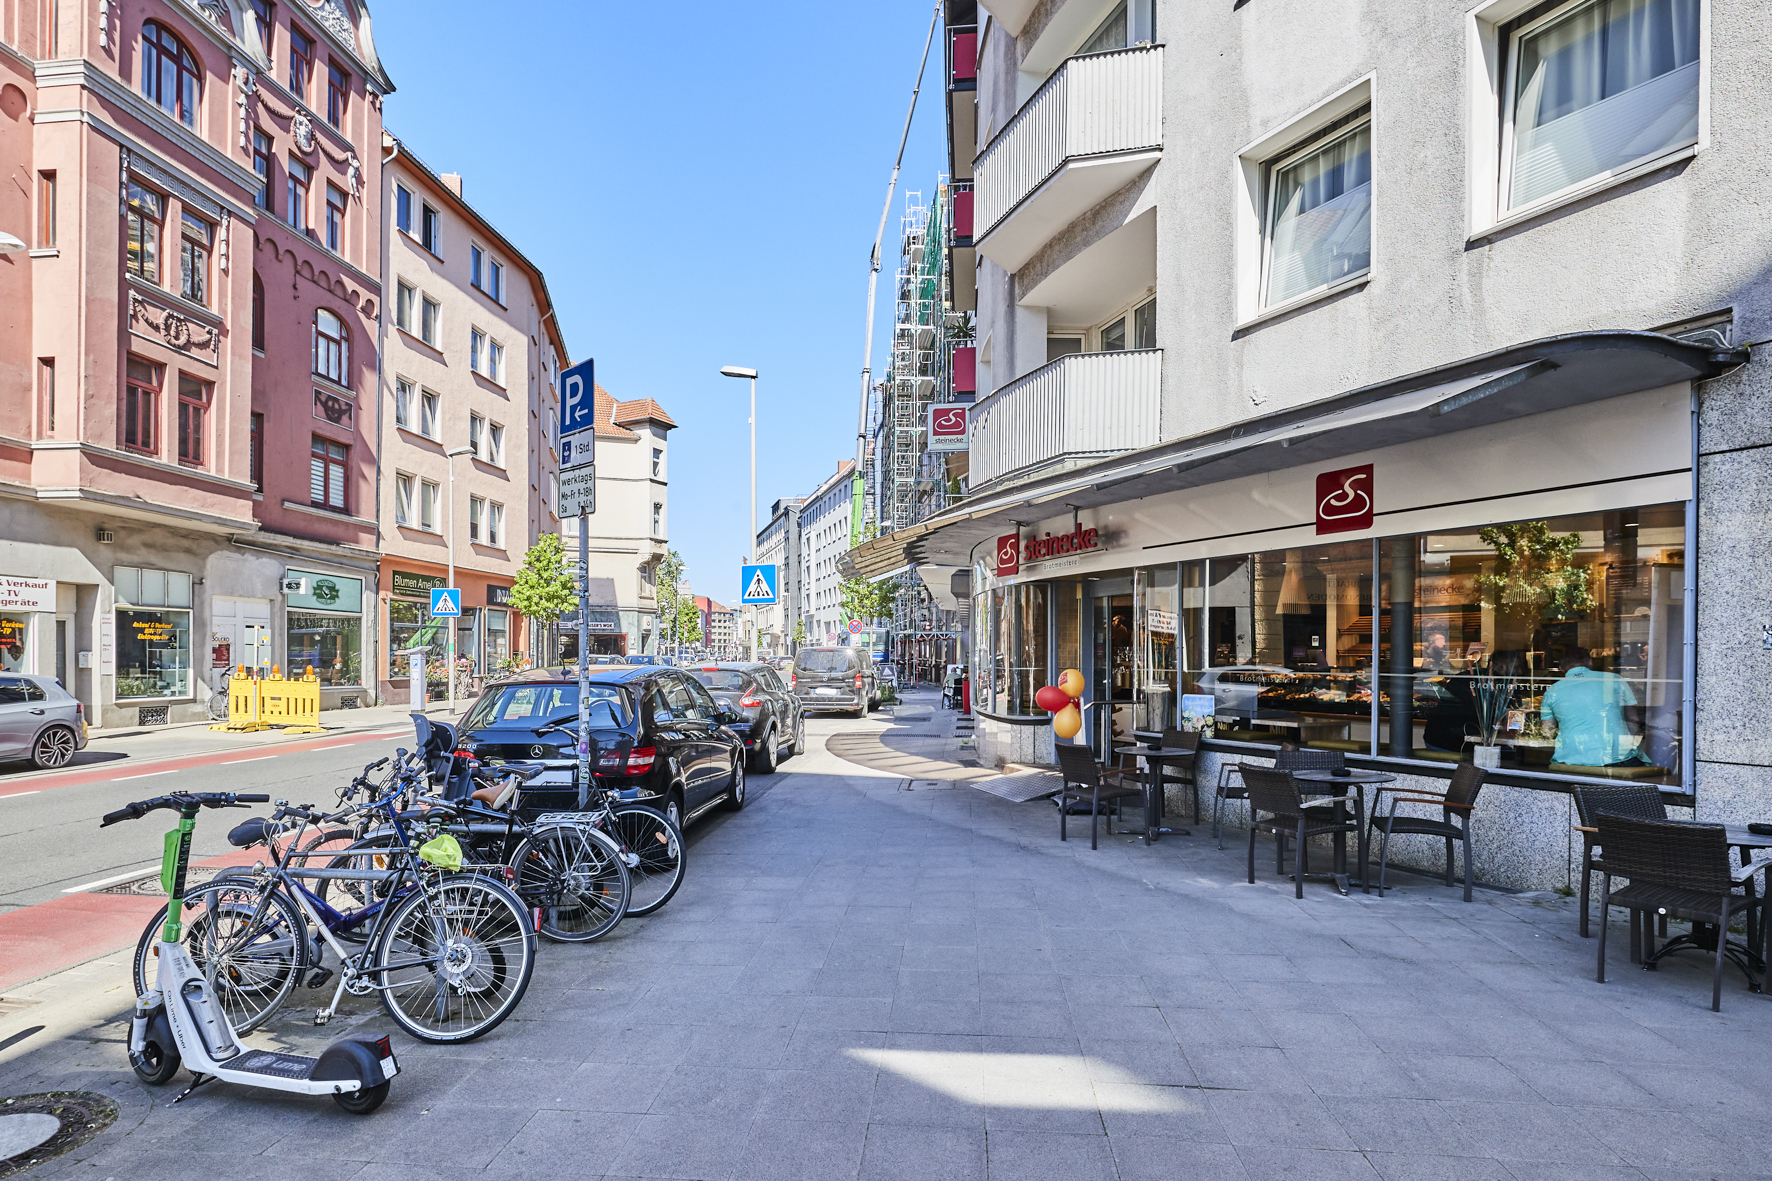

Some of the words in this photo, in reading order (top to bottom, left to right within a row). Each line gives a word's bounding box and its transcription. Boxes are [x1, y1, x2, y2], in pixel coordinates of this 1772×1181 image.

[565, 374, 584, 426] P
[934, 436, 964, 444] steinecke
[578, 441, 592, 455] Std.
[561, 473, 593, 487] werktags
[561, 489, 576, 501] Mo-Fr
[577, 486, 593, 498] 9-18h
[561, 504, 568, 514] Sa
[1024, 522, 1098, 561] steinecke
[1043, 558, 1080, 570] Brotmeisterei
[6, 579, 49, 589] Verkauf
[394, 574, 417, 588] Blumen
[417, 578, 433, 590] Amel
[1414, 583, 1464, 597] steinecke
[1, 598, 39, 606] geräte
[169, 1001, 178, 1023] Lime
[177, 1029, 187, 1050] Uber
[272, 1060, 307, 1071] Lime
